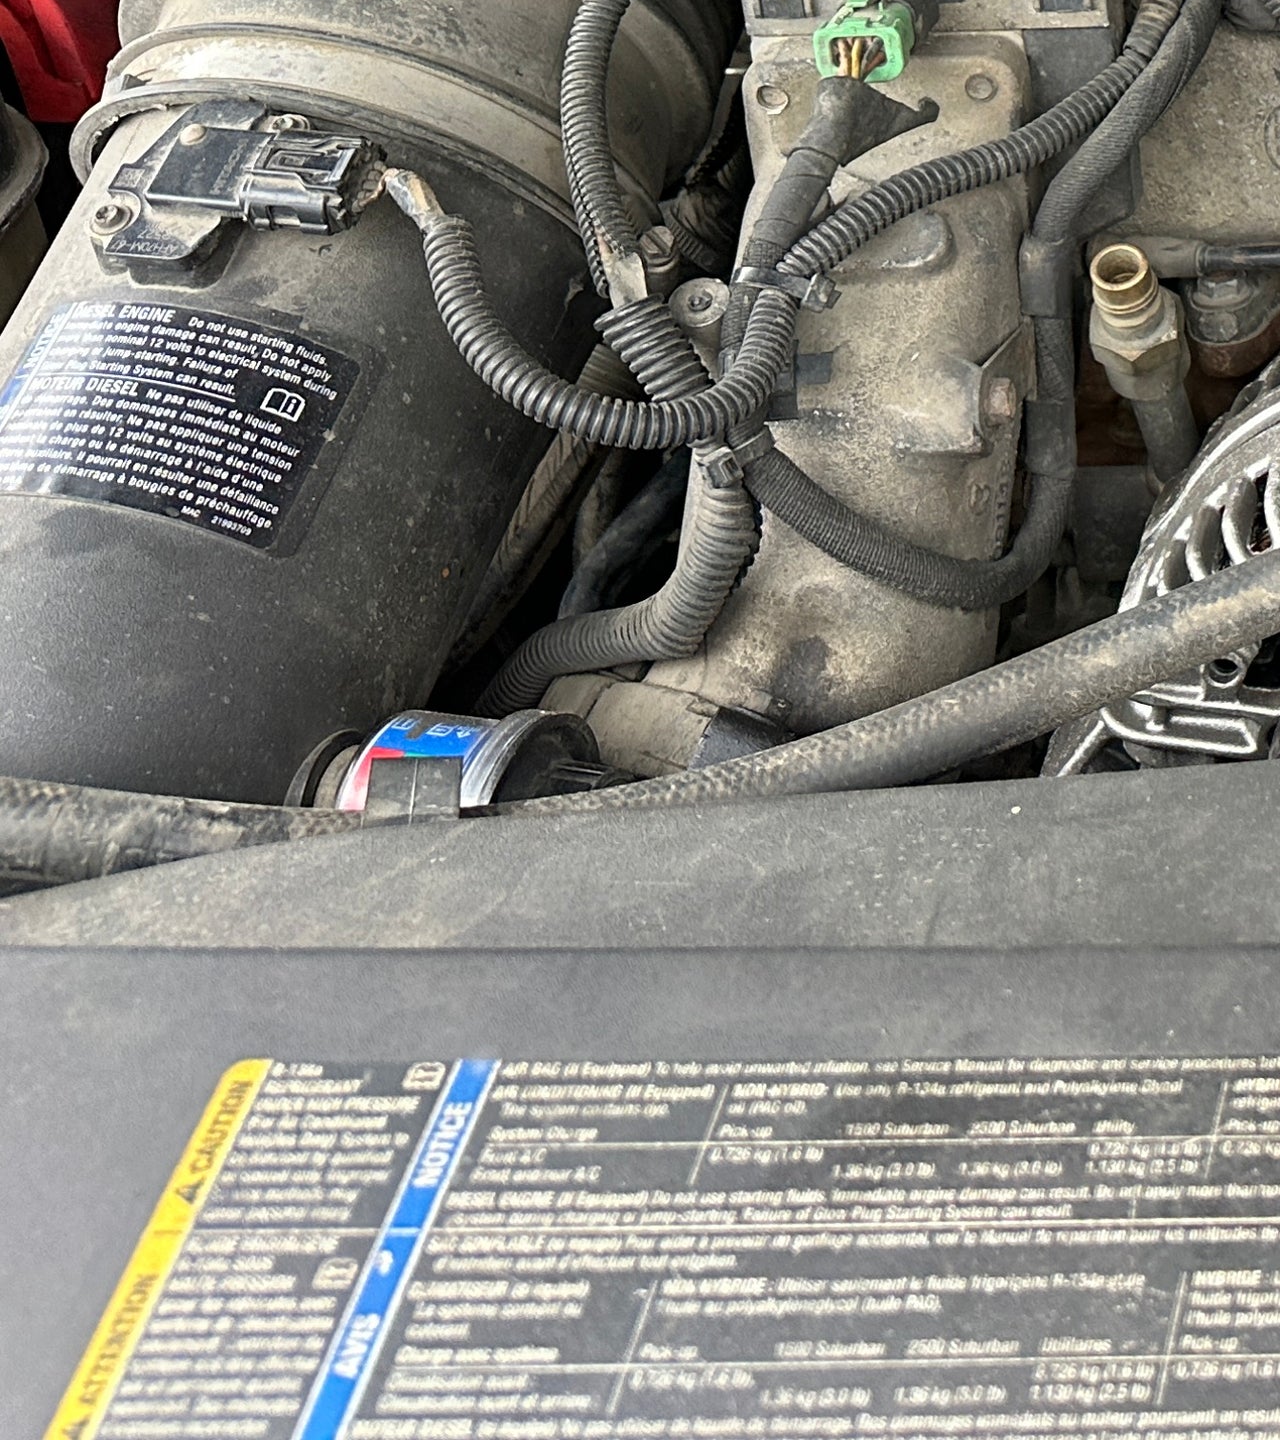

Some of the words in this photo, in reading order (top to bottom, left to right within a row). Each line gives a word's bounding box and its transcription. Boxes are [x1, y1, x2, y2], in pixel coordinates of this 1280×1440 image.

[103, 346, 180, 367] jump-starting.
[182, 356, 223, 376] Failure
[224, 367, 239, 379] of
[114, 321, 150, 334] engine
[151, 323, 197, 341] damage
[198, 332, 220, 345] can
[261, 347, 280, 361] Do
[280, 354, 301, 369] not
[301, 362, 332, 383] apply
[118, 305, 176, 324] ENGINE
[188, 316, 205, 329] Do
[206, 321, 227, 334] not
[227, 328, 249, 339] use
[250, 332, 294, 354] starting
[295, 345, 328, 367] fluids.
[89, 360, 132, 375] Starting
[132, 364, 175, 381] System
[176, 372, 198, 385] can
[200, 378, 237, 396] result.
[104, 334, 148, 347] nominal
[149, 336, 164, 348] 12
[165, 339, 193, 354] volts
[194, 344, 206, 357] to
[208, 347, 261, 371] electrical
[261, 363, 301, 385] system
[303, 379, 338, 402] during
[28, 376, 86, 392] MOTEUR
[85, 377, 140, 396] DIESEL
[146, 388, 163, 401] Ne
[163, 392, 186, 406] pas
[187, 397, 228, 417] utiliser
[228, 408, 244, 421] de
[243, 413, 283, 435] liquide
[92, 396, 114, 408] Des
[115, 398, 178, 418] dommages
[242, 430, 259, 443] au
[260, 436, 301, 458] moteur
[48, 434, 87, 448] charge
[88, 438, 104, 449] ou
[105, 440, 118, 452] le
[119, 442, 183, 466] démarrage
[184, 455, 193, 469] à
[195, 461, 230, 480] l'aide
[231, 473, 264, 492] d'une
[64, 421, 89, 434] plus
[91, 423, 106, 435] de
[108, 425, 125, 438] 12
[126, 430, 155, 444] volts
[156, 436, 173, 448] au
[174, 441, 224, 463] système
[225, 455, 283, 484] électrique
[127, 414, 144, 427] Ne
[144, 418, 166, 431] pas
[169, 424, 225, 447] appliquer
[226, 440, 250, 455] une
[251, 447, 293, 471] tension
[37, 462, 52, 473] de
[53, 464, 115, 483] démarrage
[117, 472, 126, 485] à
[128, 474, 177, 496] bougies
[178, 488, 195, 502] de
[195, 494, 274, 530] préchauffage.
[85, 452, 132, 470] pourrait
[133, 461, 148, 474] en
[149, 465, 196, 486] résulter
[196, 479, 219, 493] une
[220, 485, 280, 515] défaillance
[180, 505, 202, 518] MAC
[901, 1059, 953, 1074] Service
[1029, 1056, 1099, 1075] diagnostic
[190, 1079, 253, 1174] CAUTION
[411, 1101, 473, 1189] NOTICE
[333, 1313, 381, 1379] AVIS
